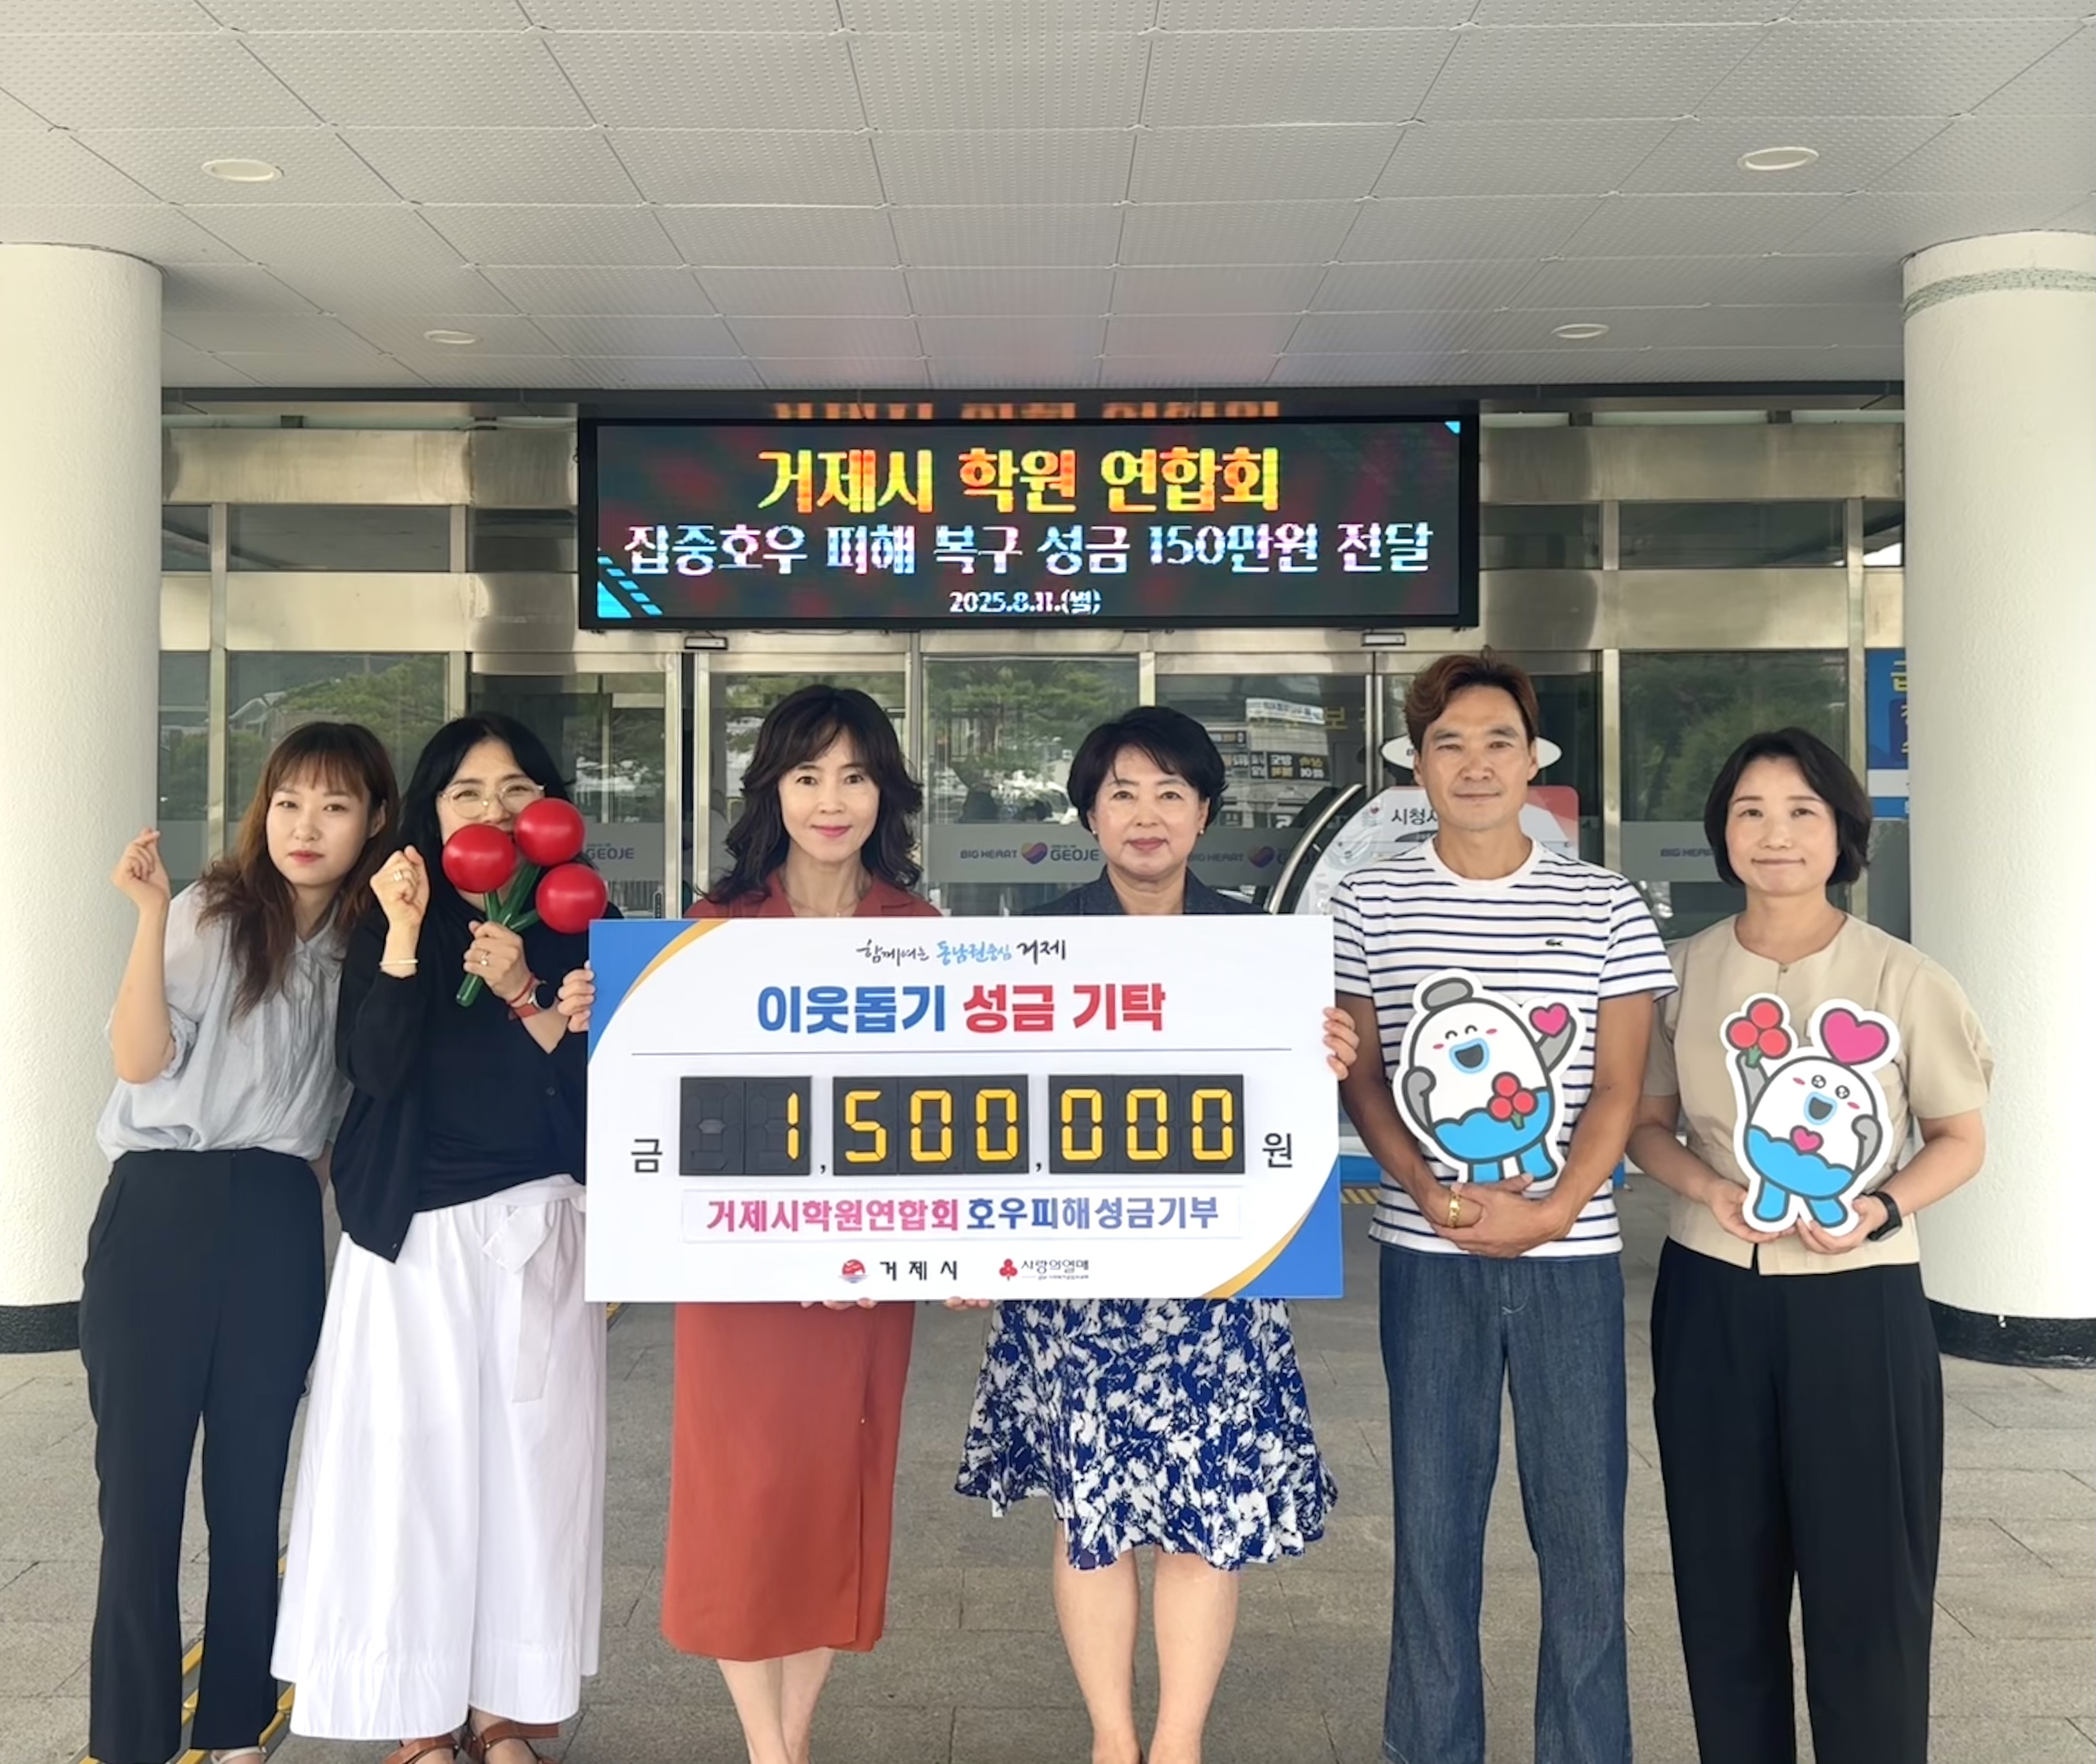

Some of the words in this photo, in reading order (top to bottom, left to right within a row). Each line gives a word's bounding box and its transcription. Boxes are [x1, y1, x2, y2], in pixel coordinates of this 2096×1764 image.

[757, 448, 933, 513] 거제시
[958, 446, 1076, 513] 학원
[1100, 447, 1279, 512] 연합회
[624, 524, 808, 576] 집중호우
[827, 524, 916, 576] 피해
[933, 524, 1023, 576] 복구
[1037, 523, 1131, 576] 성금
[1149, 523, 1318, 575] 150만원
[1336, 521, 1434, 575] 전달
[585, 848, 634, 860] GEOJE
[960, 850, 979, 859] BIG
[980, 850, 1017, 859] HEART
[1050, 849, 1100, 862] GEOJE
[1016, 939, 1067, 965] 거제
[757, 985, 946, 1034] 이웃돕기
[963, 985, 1055, 1032] 성금
[1073, 983, 1167, 1031] 기탁
[630, 1138, 663, 1173] 금
[1262, 1132, 1294, 1169] 원
[706, 1200, 958, 1232] 거제시학원연합회
